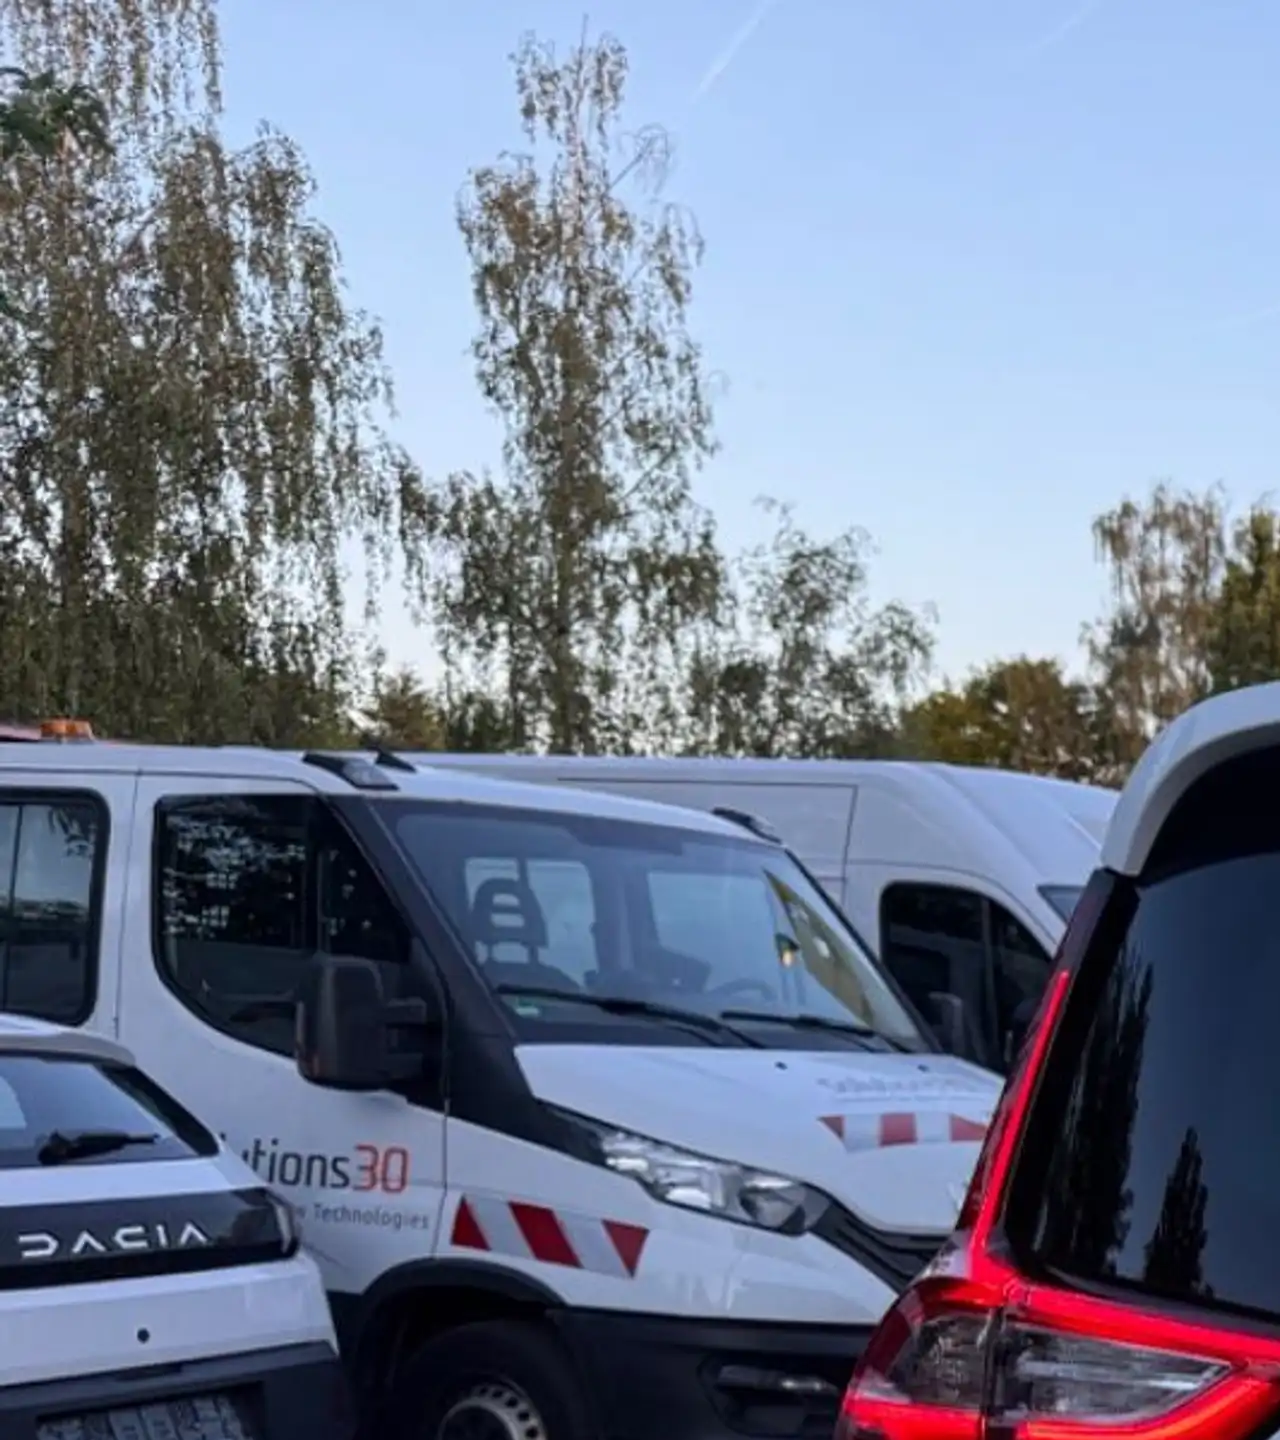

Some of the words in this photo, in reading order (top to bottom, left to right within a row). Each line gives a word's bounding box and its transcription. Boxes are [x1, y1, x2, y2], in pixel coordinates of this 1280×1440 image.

[219, 1132, 410, 1194] tions30
[314, 1203, 430, 1231] Technologies
[17, 1220, 209, 1259] DACIA
